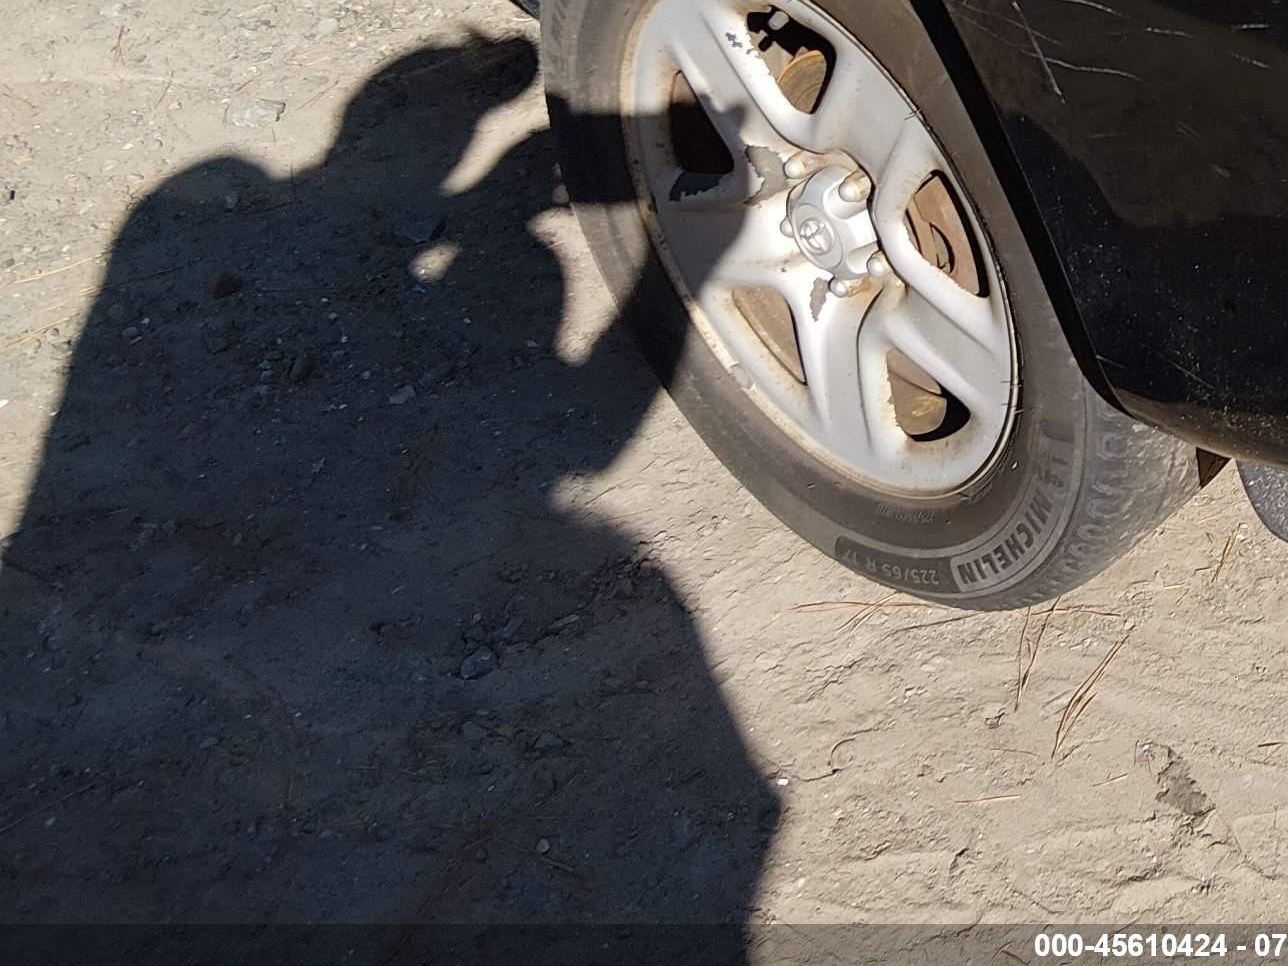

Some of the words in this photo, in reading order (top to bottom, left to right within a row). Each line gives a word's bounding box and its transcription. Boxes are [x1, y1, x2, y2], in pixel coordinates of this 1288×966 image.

[956, 488, 1053, 585] MICHELIN
[864, 556, 877, 573] R
[881, 562, 940, 585] 225/65
